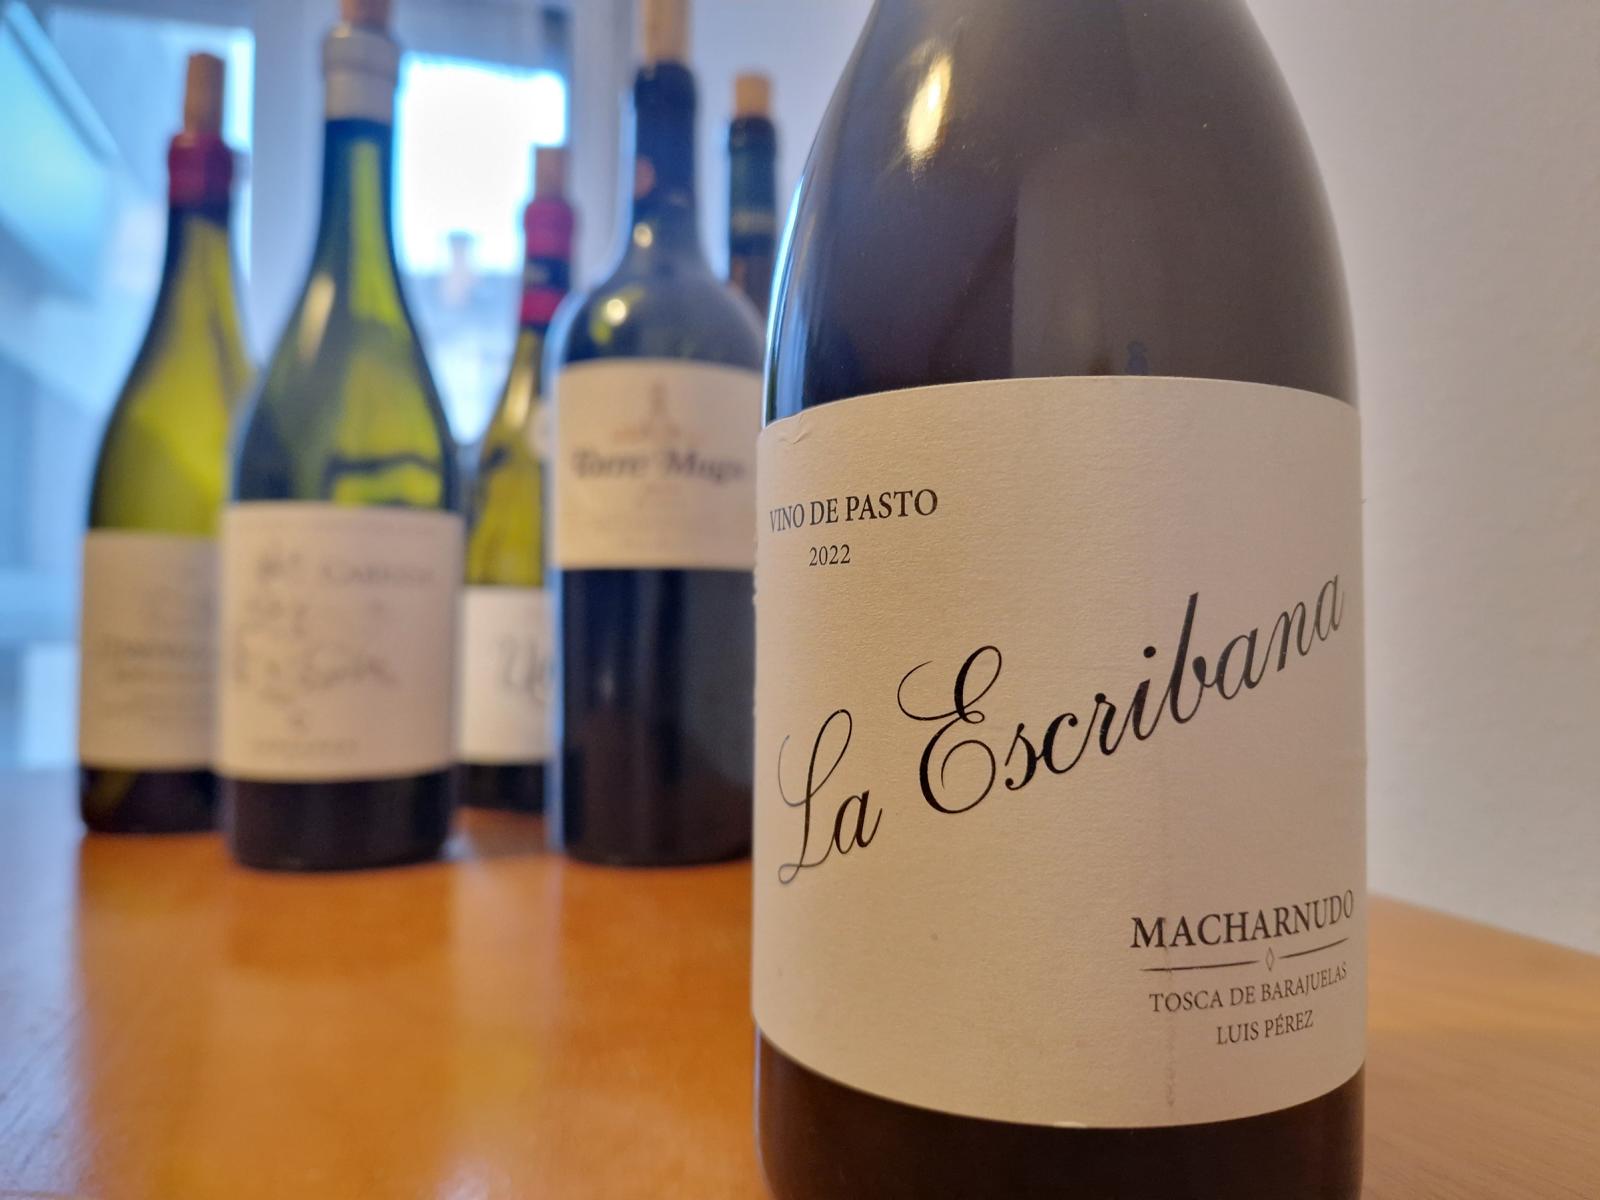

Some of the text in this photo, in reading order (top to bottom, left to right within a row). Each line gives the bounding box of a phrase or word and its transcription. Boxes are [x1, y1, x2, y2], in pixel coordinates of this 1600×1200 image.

[769, 489, 938, 532] VINO DE PASTO
[809, 544, 851, 567] 2022
[778, 574, 1344, 885] La Escribana
[1130, 889, 1354, 949] MACHARNUDO
[1149, 962, 1348, 1013] TOSCA DE BARAJUELAS
[1216, 1009, 1314, 1046] LUIS PÉREZ
